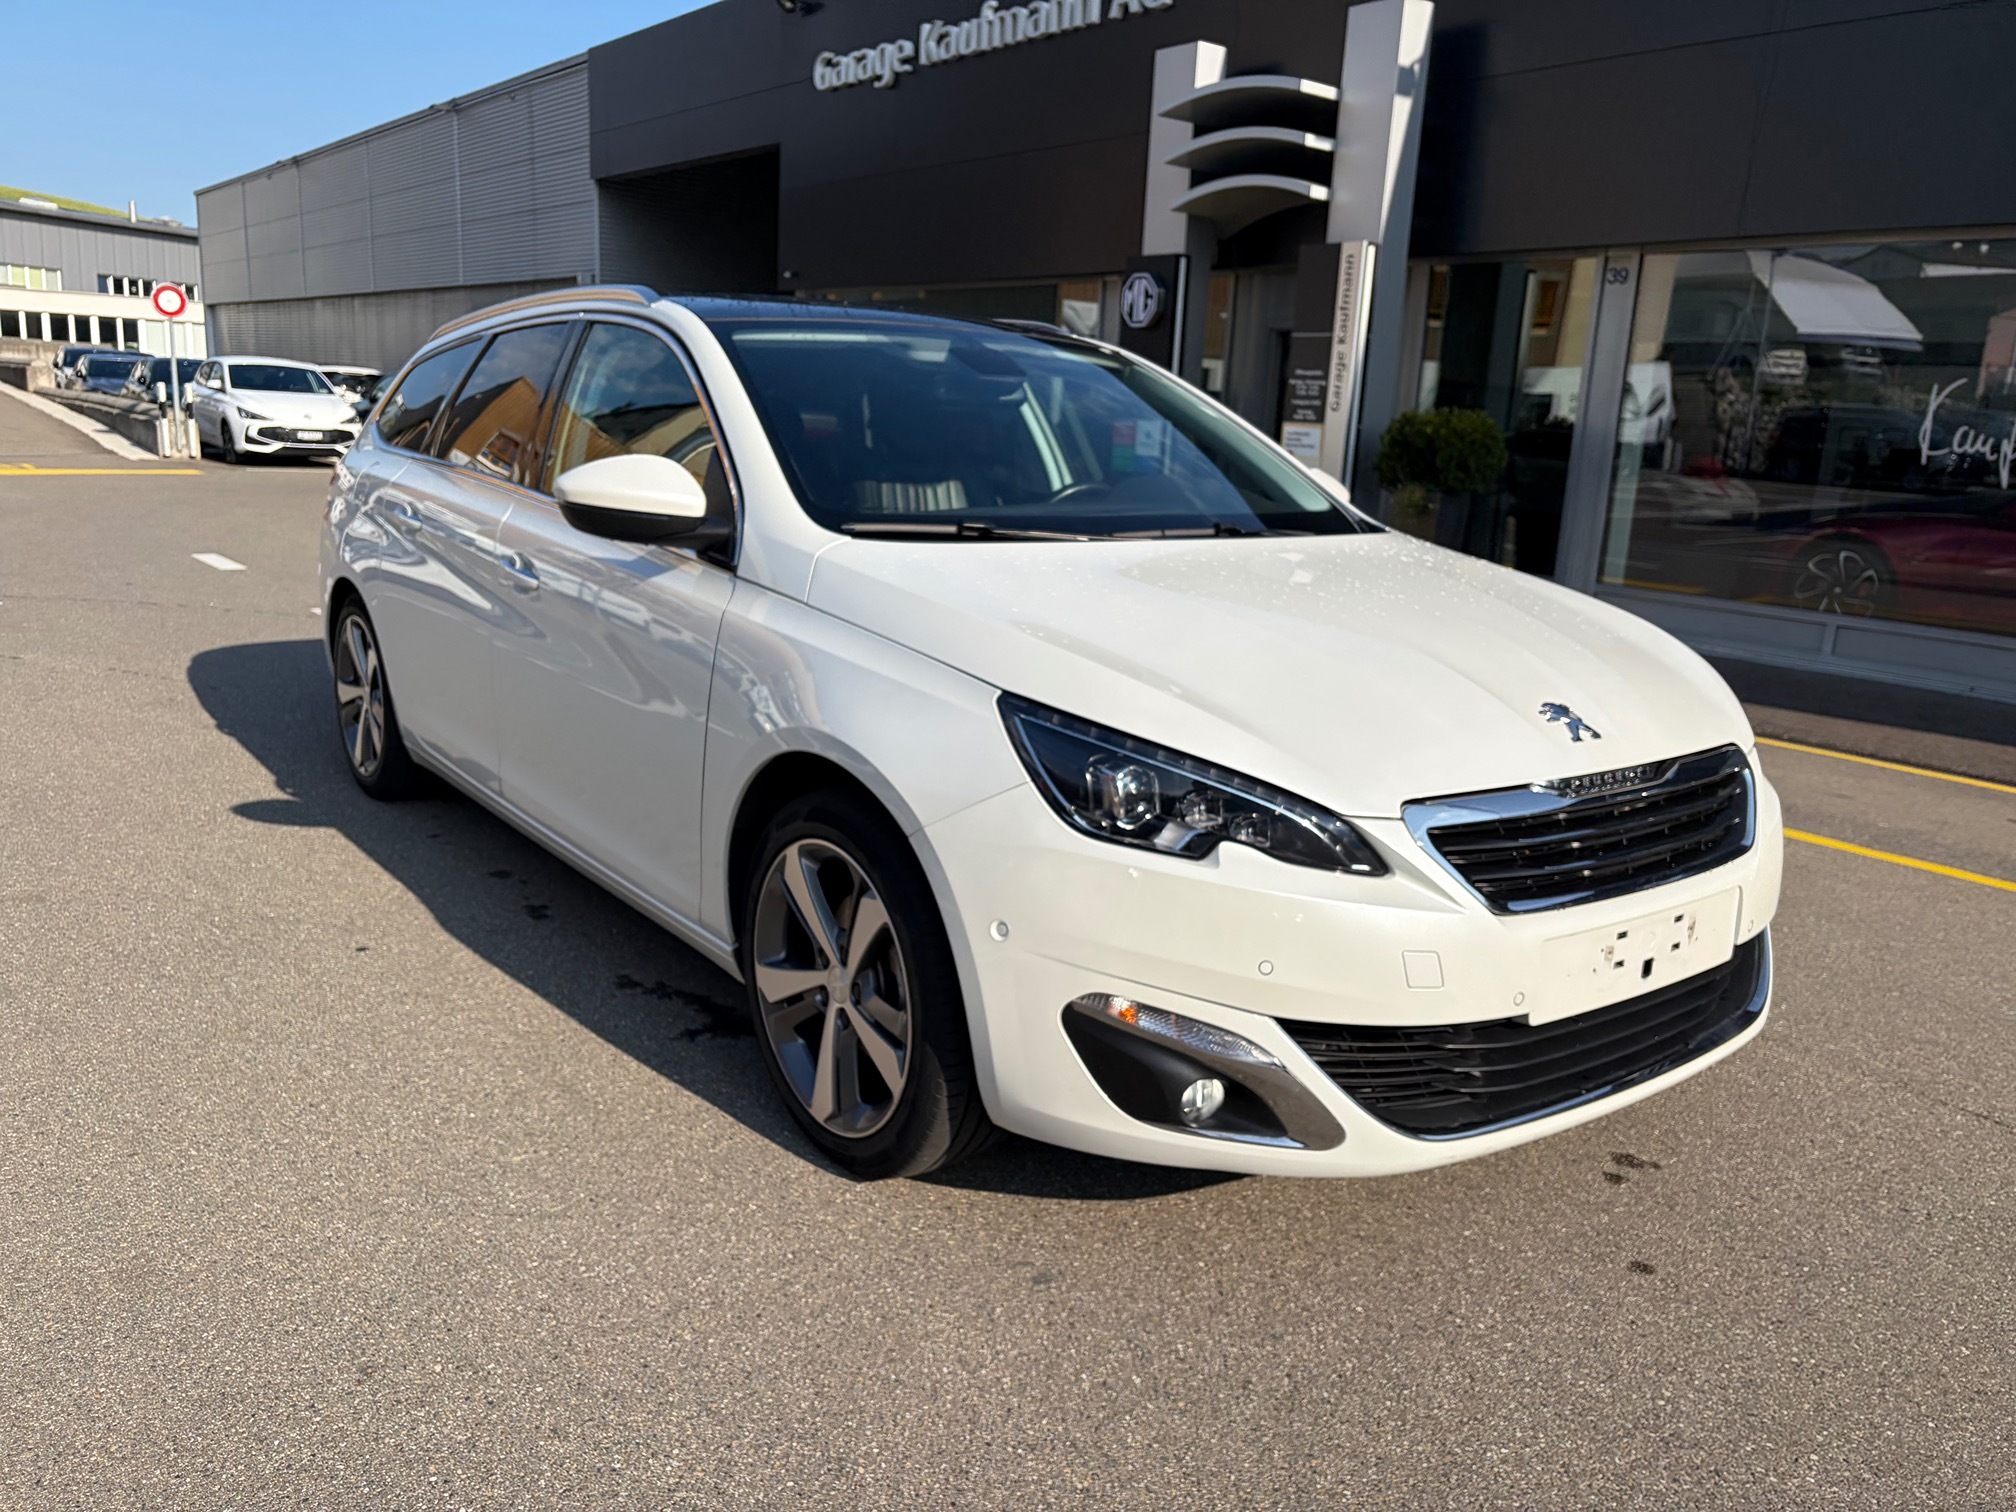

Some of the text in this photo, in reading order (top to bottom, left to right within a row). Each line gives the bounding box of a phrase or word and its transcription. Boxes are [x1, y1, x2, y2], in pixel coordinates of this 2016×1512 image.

[812, 38, 915, 91] Garage
[918, 0, 1101, 65] Kaufmann
[1123, 277, 1154, 322] MG
[1606, 266, 1629, 285] 39
[1329, 253, 1355, 412] Garage Kaufmann
